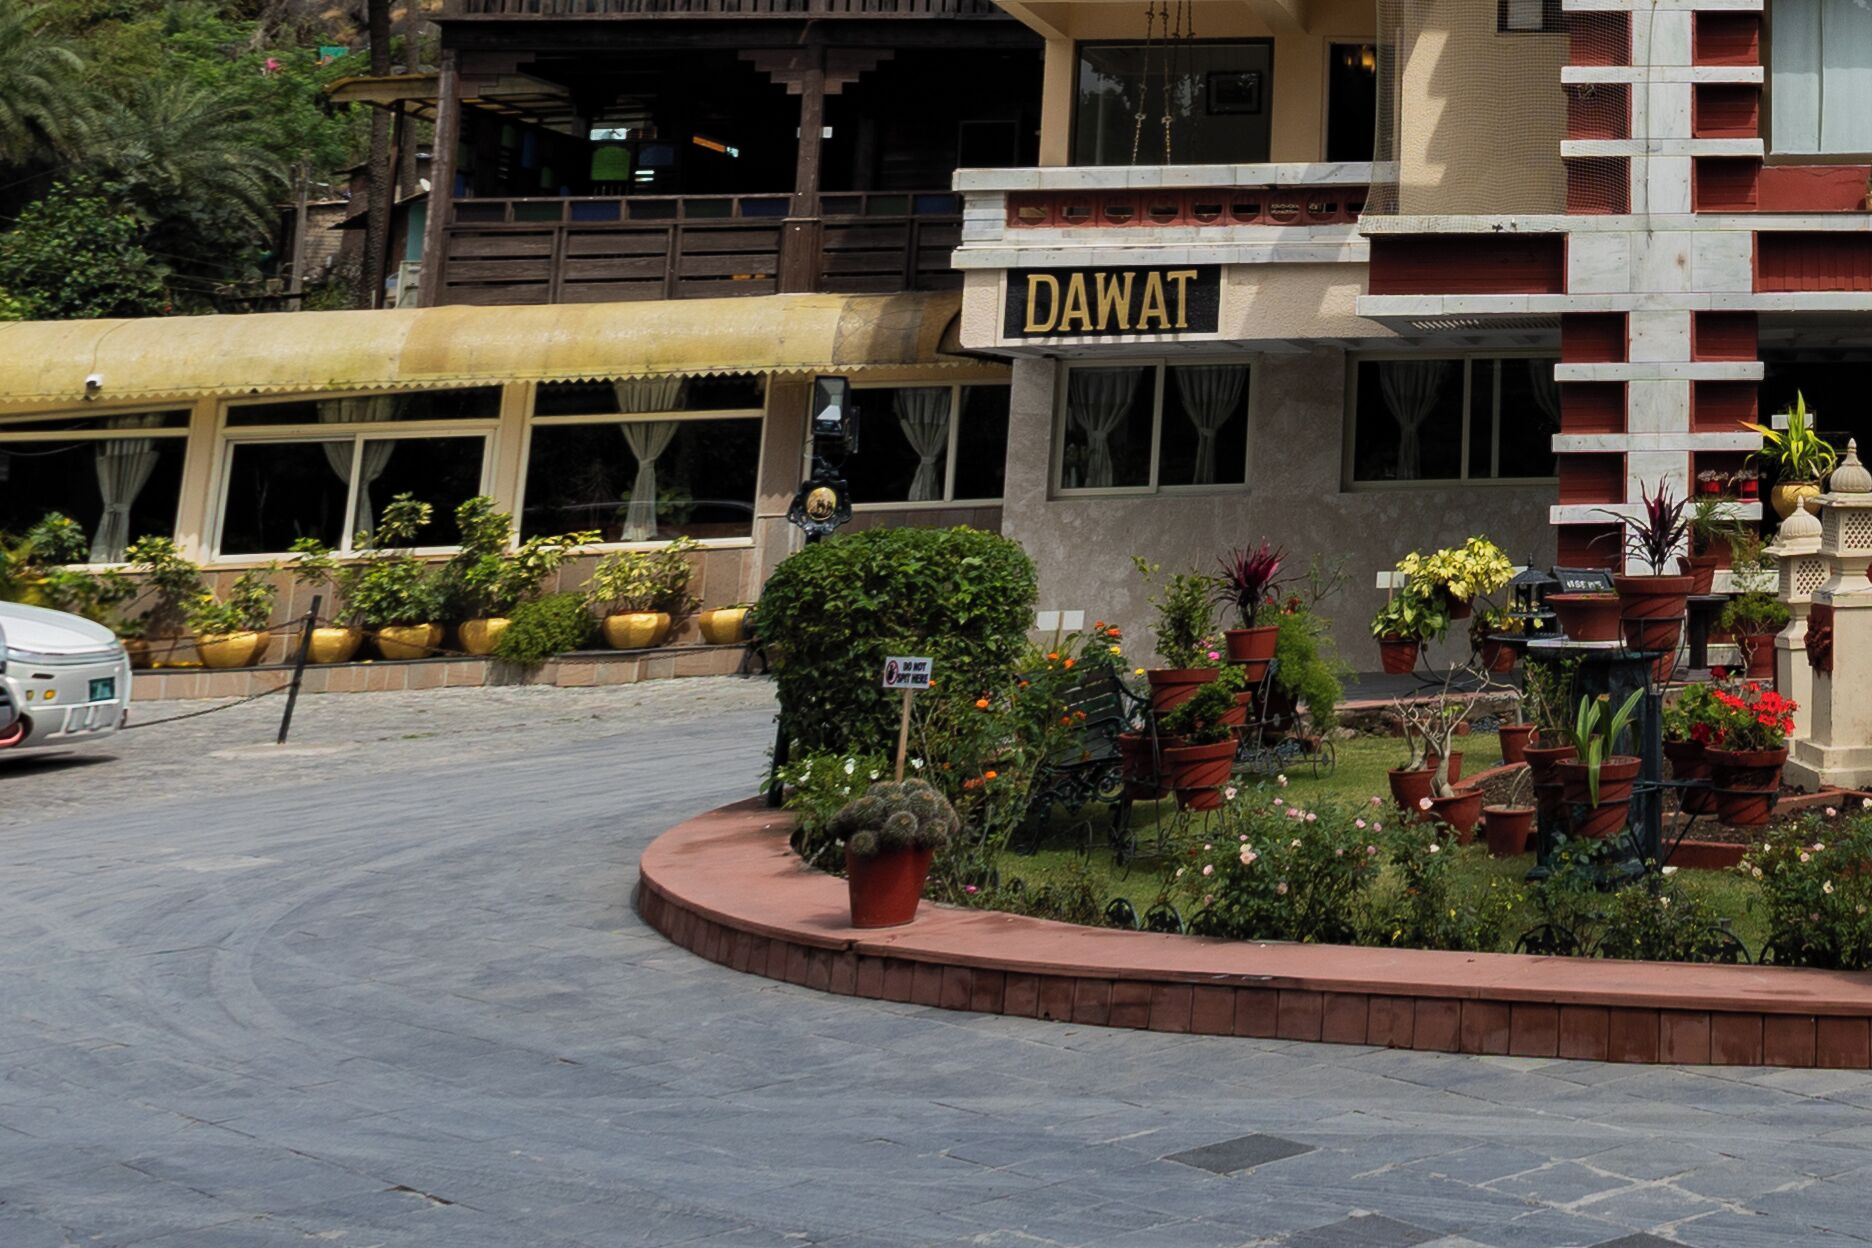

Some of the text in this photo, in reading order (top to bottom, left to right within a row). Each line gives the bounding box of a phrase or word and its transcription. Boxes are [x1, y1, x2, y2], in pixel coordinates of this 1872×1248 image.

[1023, 269, 1198, 333] DAWAT
[903, 661, 927, 671] DO NOT
[897, 673, 928, 684] SPIT HERE
